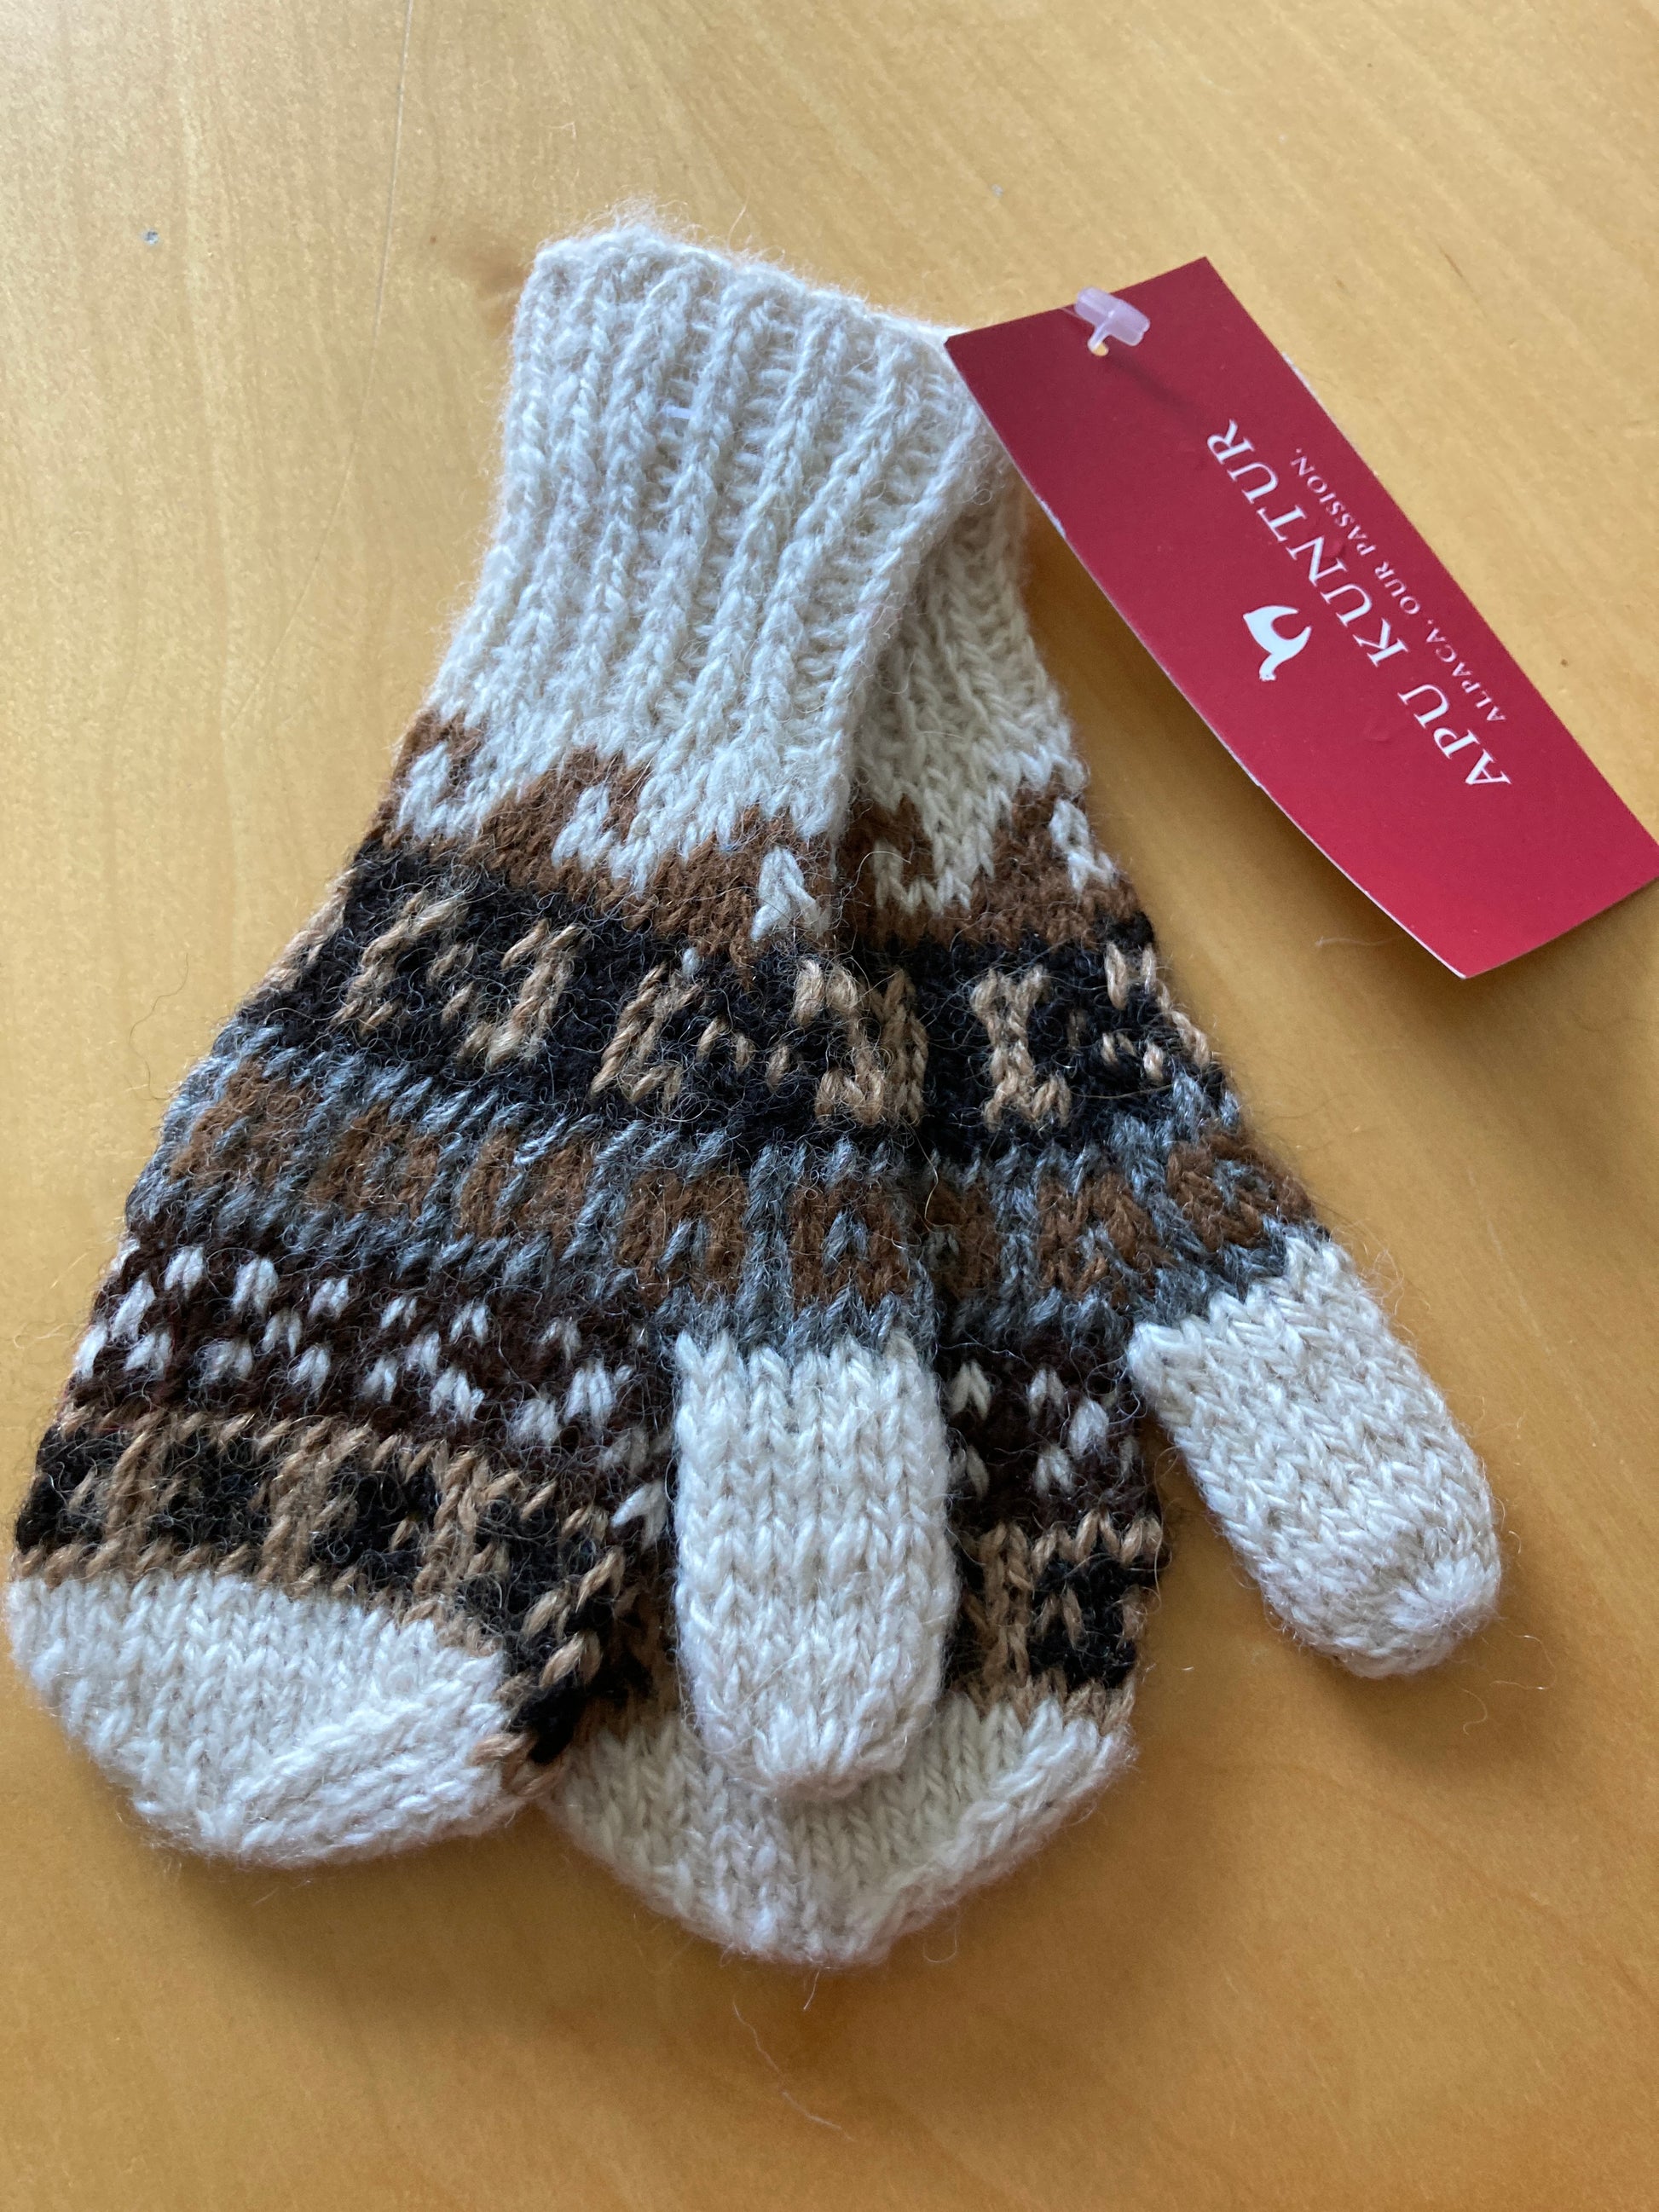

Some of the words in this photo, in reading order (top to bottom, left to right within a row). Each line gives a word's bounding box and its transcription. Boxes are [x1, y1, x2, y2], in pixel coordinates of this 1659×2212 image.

[1206, 419, 1408, 667] KUNTUR
[1291, 448, 1376, 556] PASSION.
[1374, 561, 1421, 615] OUR
[1426, 619, 1506, 723] ALPACA.
[1397, 684, 1512, 785] APU
